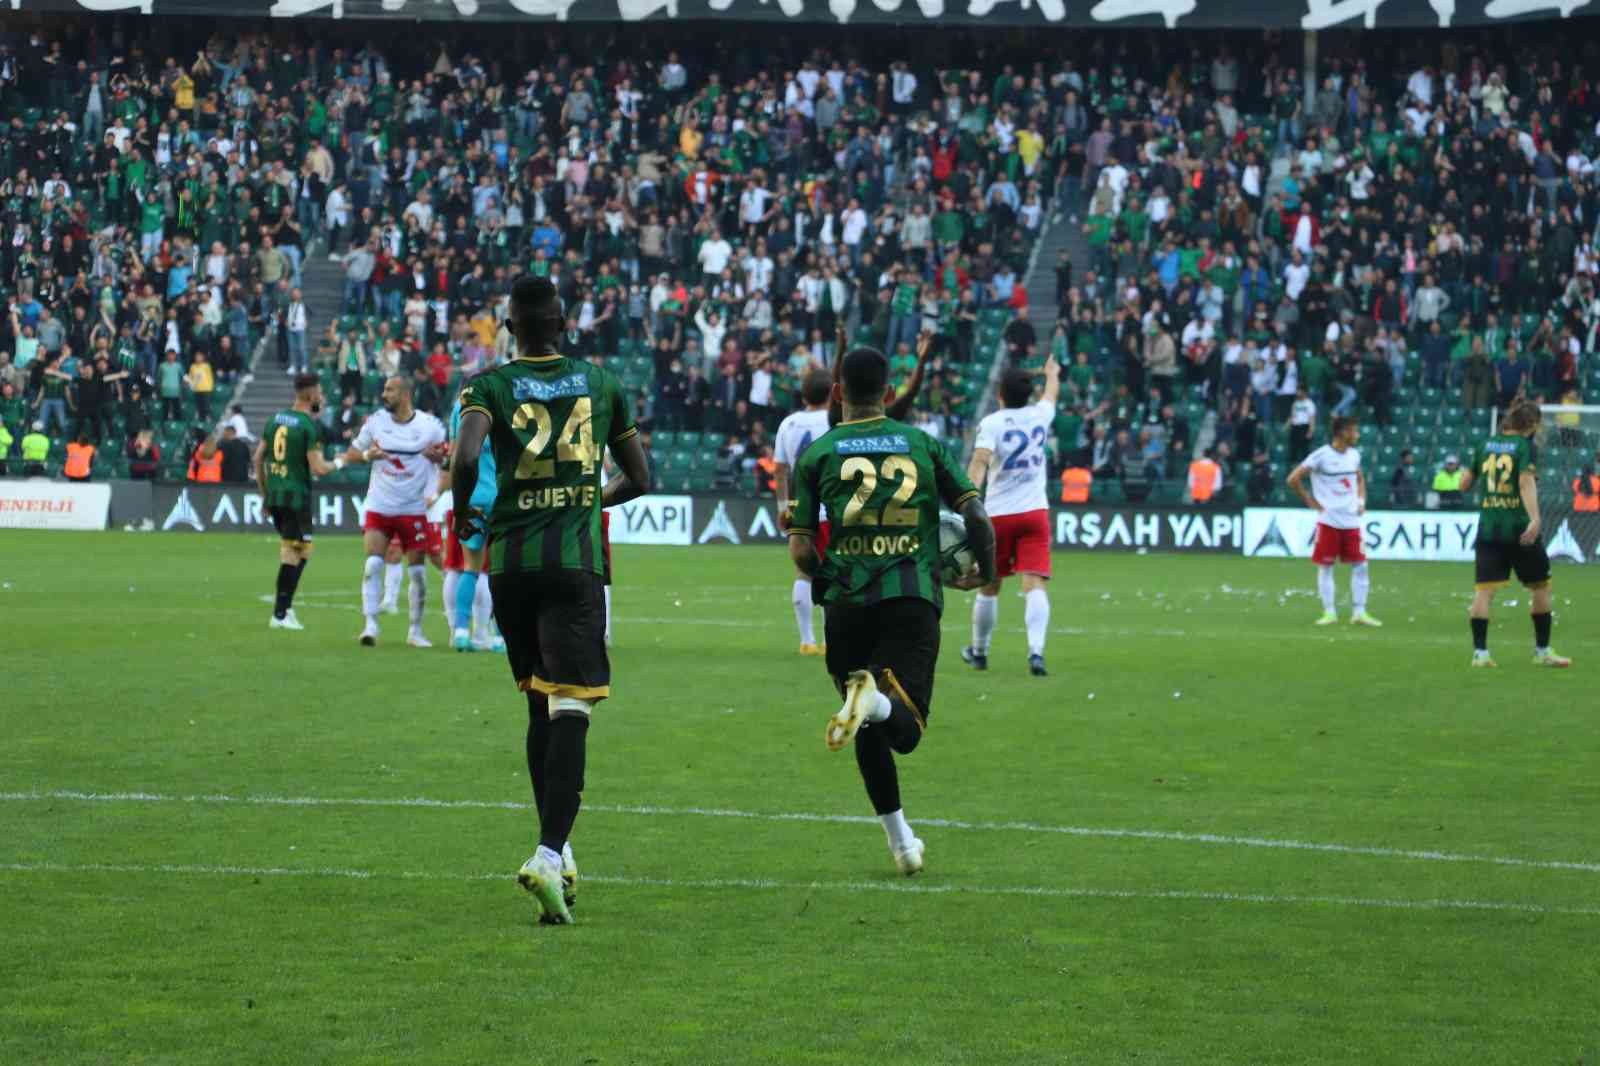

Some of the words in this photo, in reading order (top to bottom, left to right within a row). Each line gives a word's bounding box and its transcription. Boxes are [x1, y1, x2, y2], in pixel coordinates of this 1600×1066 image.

[515, 375, 585, 393] KONAK
[273, 425, 288, 461] 6
[511, 397, 600, 480] 24
[837, 433, 905, 448] KONAK
[1482, 453, 1513, 493] 12
[518, 485, 596, 511] GUEYE
[840, 455, 919, 527] 22
[621, 504, 687, 533] YAPI
[1167, 513, 1242, 548] YAPI
